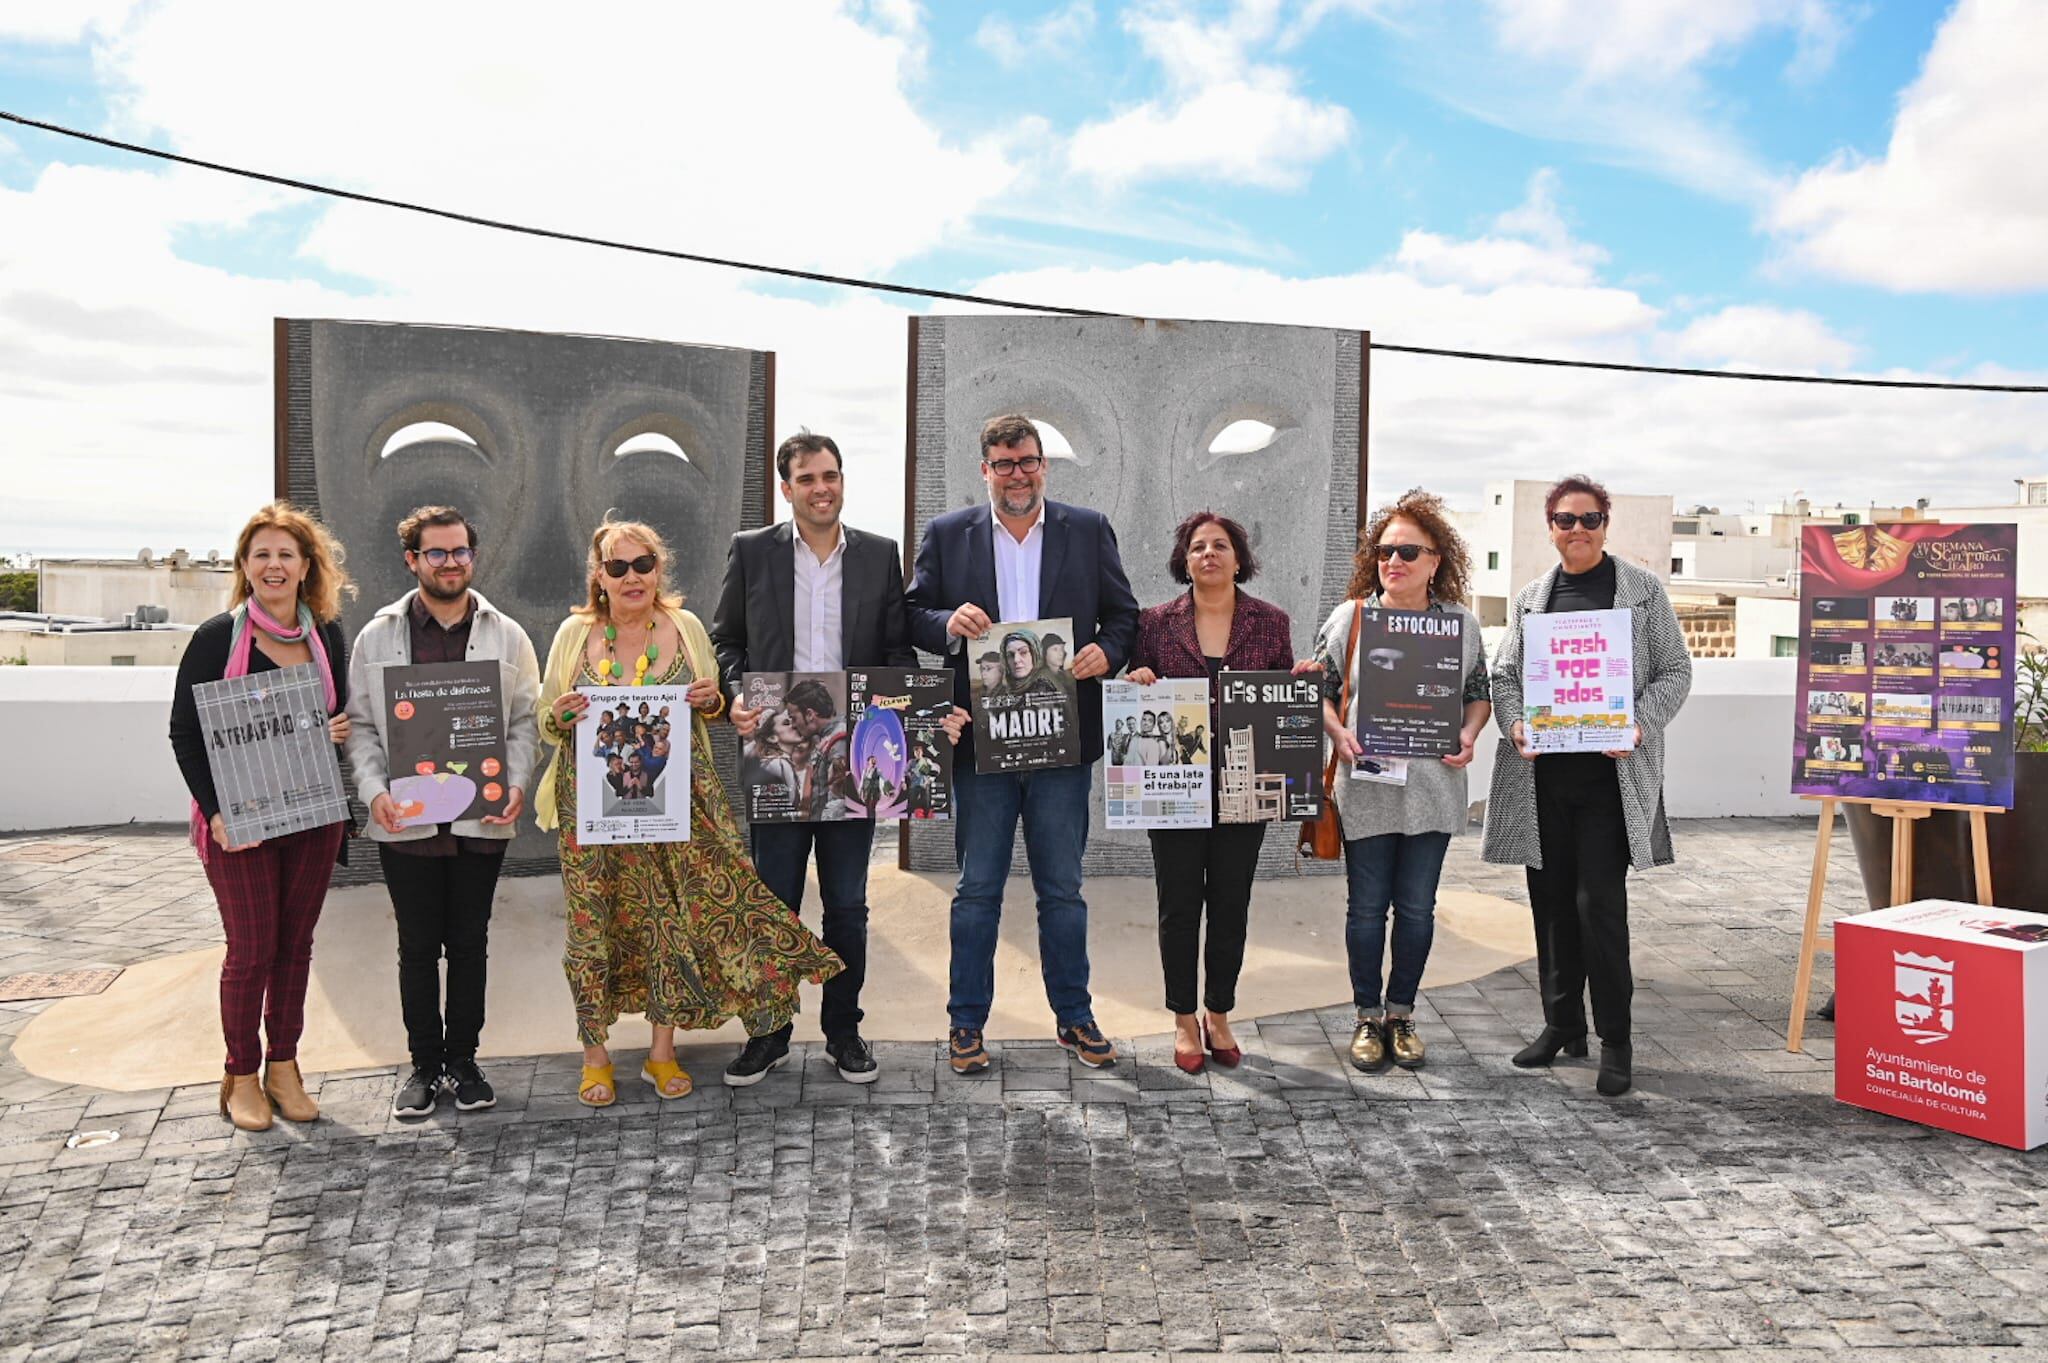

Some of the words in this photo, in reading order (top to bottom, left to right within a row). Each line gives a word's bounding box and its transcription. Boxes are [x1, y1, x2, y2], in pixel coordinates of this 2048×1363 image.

[1942, 549, 2004, 562] CULTURAL
[1388, 616, 1460, 636] ESTOCOLMO
[1550, 632, 1607, 655] trash
[395, 690, 407, 700] La
[436, 687, 448, 697] de
[450, 685, 491, 696] disfraces
[590, 694, 617, 703] Grupo
[660, 694, 677, 703] Ajei
[1554, 681, 1604, 705] ados
[988, 708, 1065, 740] MADRE
[1144, 770, 1156, 779] Es
[1159, 771, 1180, 779] una
[1183, 769, 1204, 779] lata
[1144, 781, 1155, 790] el
[1157, 780, 1203, 798] trabajar
[1866, 1047, 1962, 1081] Ayuntamiento
[1966, 1070, 1987, 1085] de
[1866, 1064, 1895, 1083] San
[1900, 1071, 1987, 1105] Bartolomé
[1866, 1083, 1924, 1105] CONCEJALÍA
[1926, 1098, 1940, 1109] DE
[1941, 1103, 1987, 1121] CULTURA
